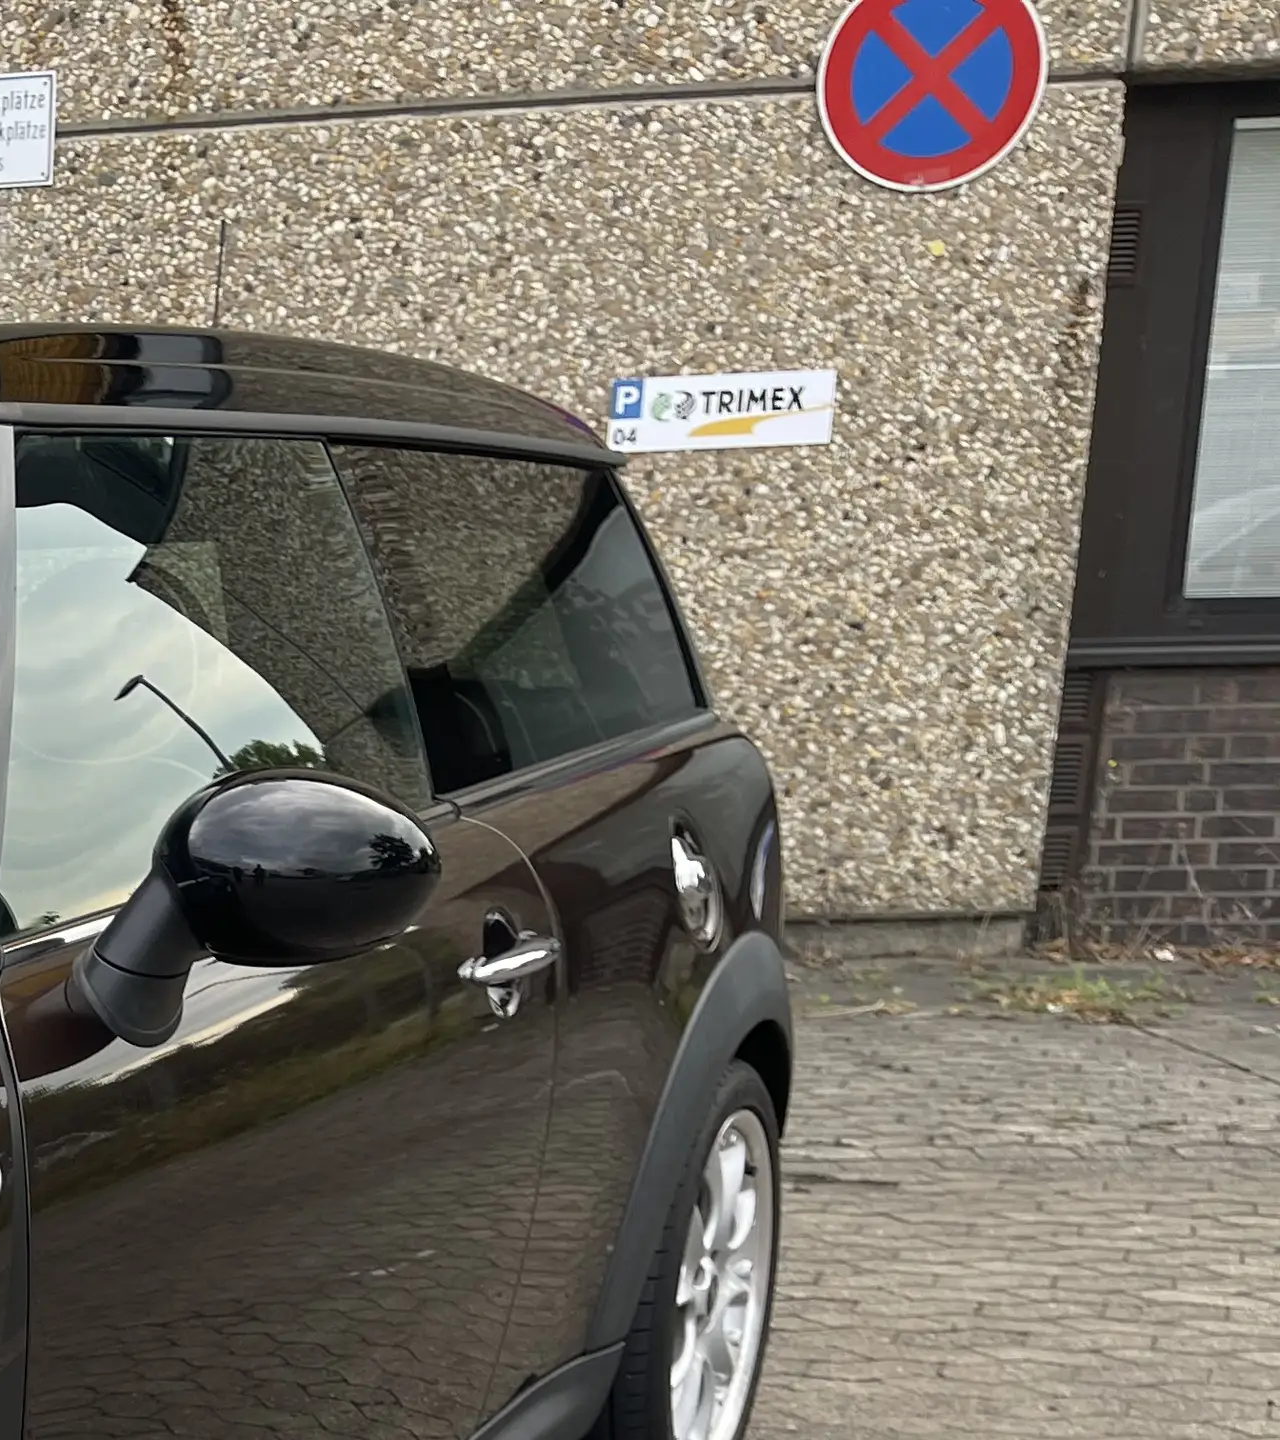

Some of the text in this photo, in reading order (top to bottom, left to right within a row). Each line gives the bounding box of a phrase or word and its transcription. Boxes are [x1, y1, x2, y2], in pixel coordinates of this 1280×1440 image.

[614, 385, 806, 415] P TRIMEX
[612, 427, 637, 446] 04
